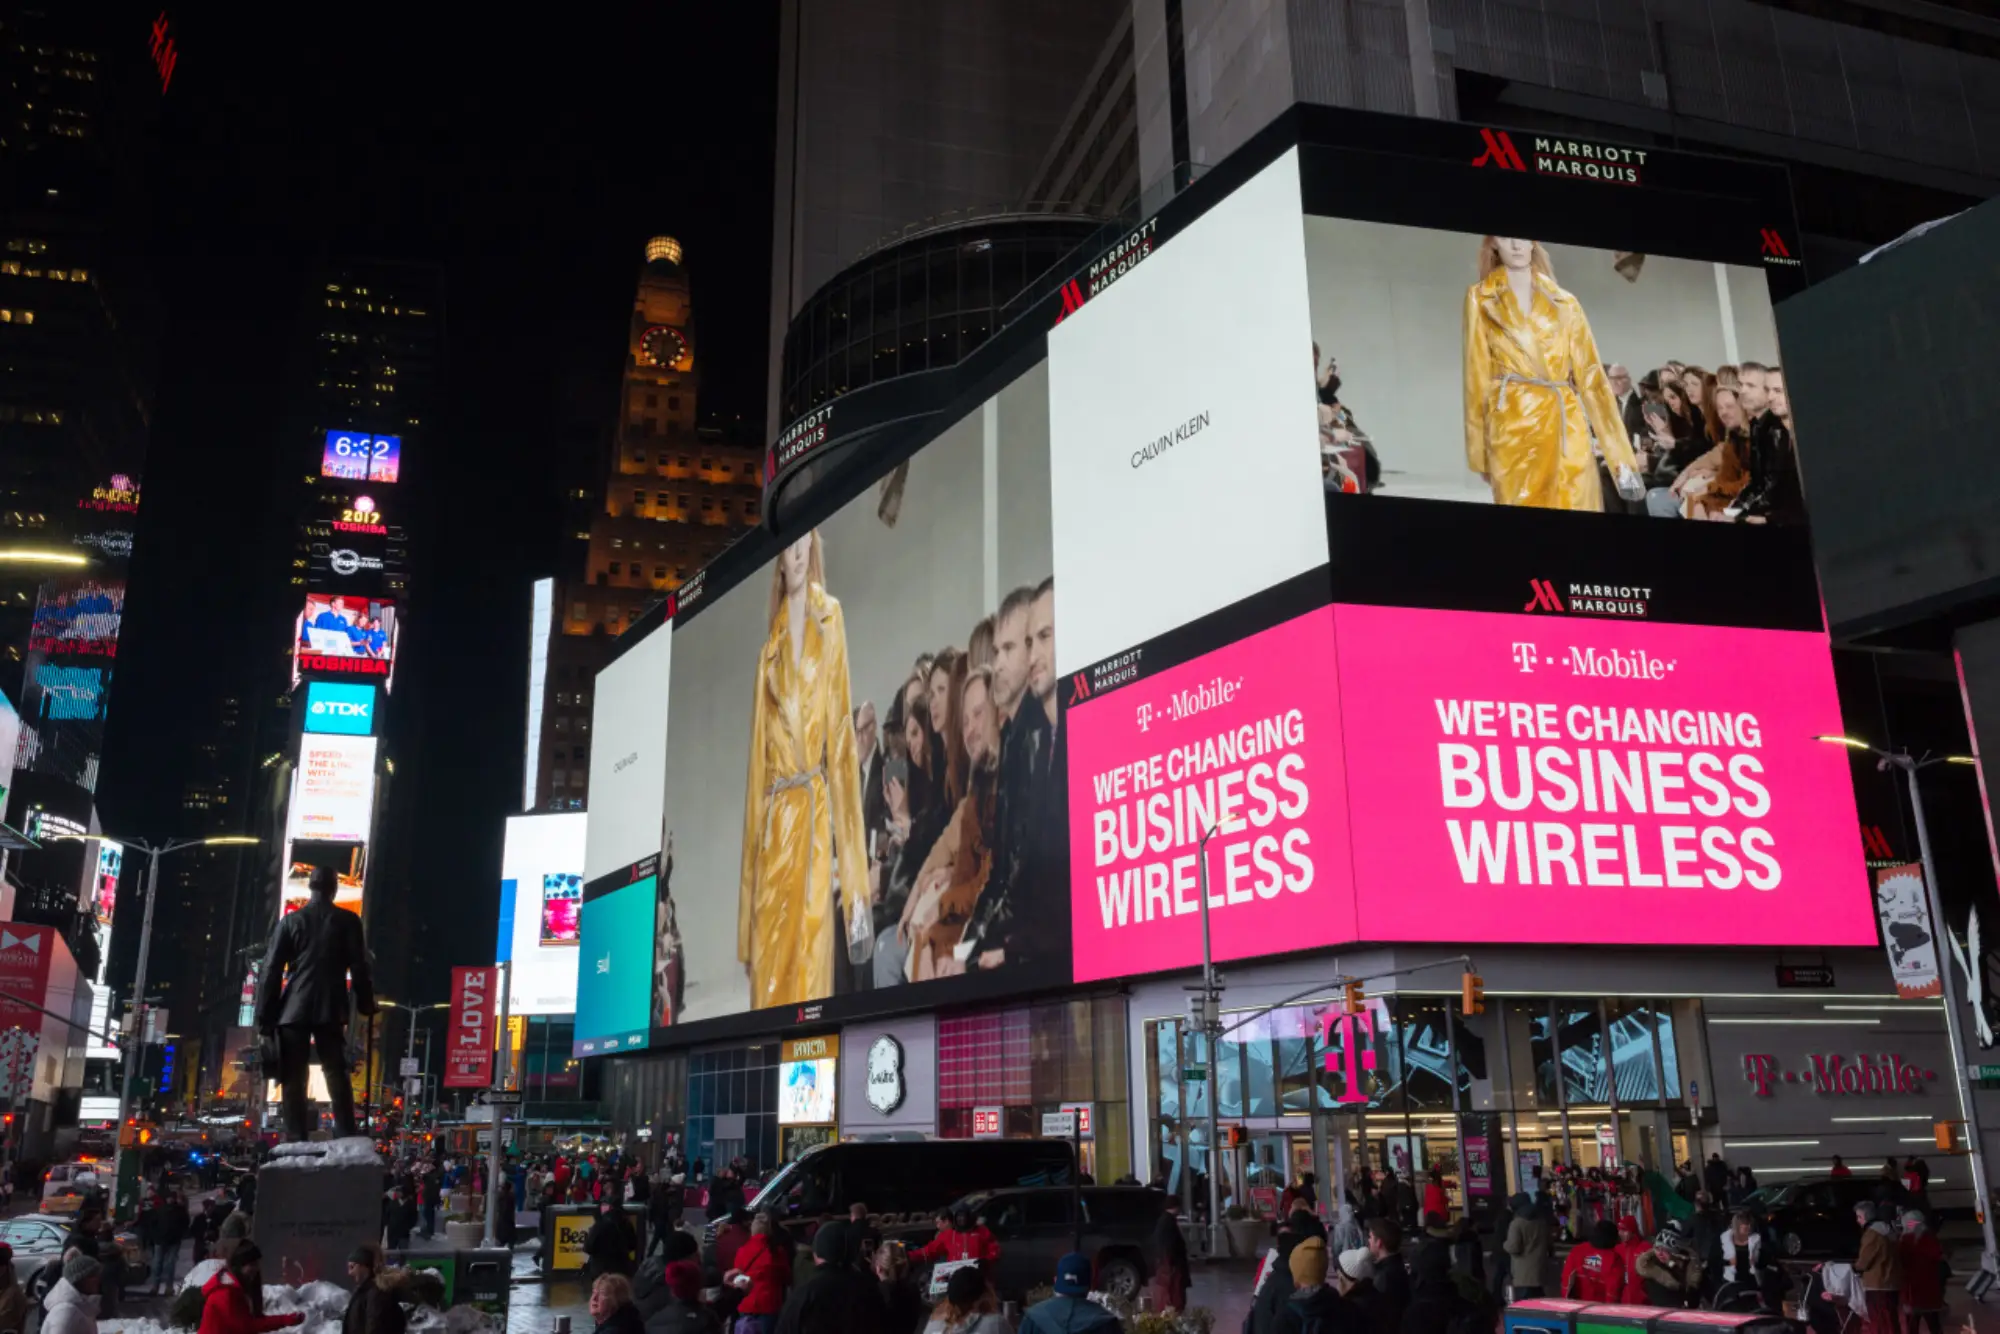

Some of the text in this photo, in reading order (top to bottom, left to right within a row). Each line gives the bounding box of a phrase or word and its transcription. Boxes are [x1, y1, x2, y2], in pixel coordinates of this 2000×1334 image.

[1535, 138, 1647, 165] MARRIOTT
[1538, 157, 1637, 183] MARQUIS
[1090, 217, 1157, 278] MARRIOTT
[1090, 243, 1149, 295] MARQUIS
[335, 437, 390, 460] 6:32
[779, 406, 833, 450] MARRIOTT
[779, 428, 824, 467] MARQUIS
[1131, 409, 1209, 469] CALVIN KLEIN
[332, 520, 387, 535] TOSHIBA
[342, 509, 380, 524] 2017
[1570, 583, 1652, 599] MARRIOTT
[1572, 599, 1645, 615] MARQUIS
[300, 655, 388, 674] TOSHIBA
[1095, 649, 1142, 677] MARRIOTT
[1095, 664, 1137, 692] MARQUIS
[325, 701, 368, 717] TDK
[1435, 699, 1762, 749] WE'RE CHANGING
[1093, 708, 1305, 805] WE'RE CHANGING
[1437, 742, 1772, 818] BUSINESS
[1094, 753, 1309, 867] BUSINESS
[1446, 819, 1782, 891] WIRELESS
[1096, 828, 1314, 930] WIRELESS
[460, 971, 486, 1045] LOVE
[1323, 1009, 1376, 1103] T
